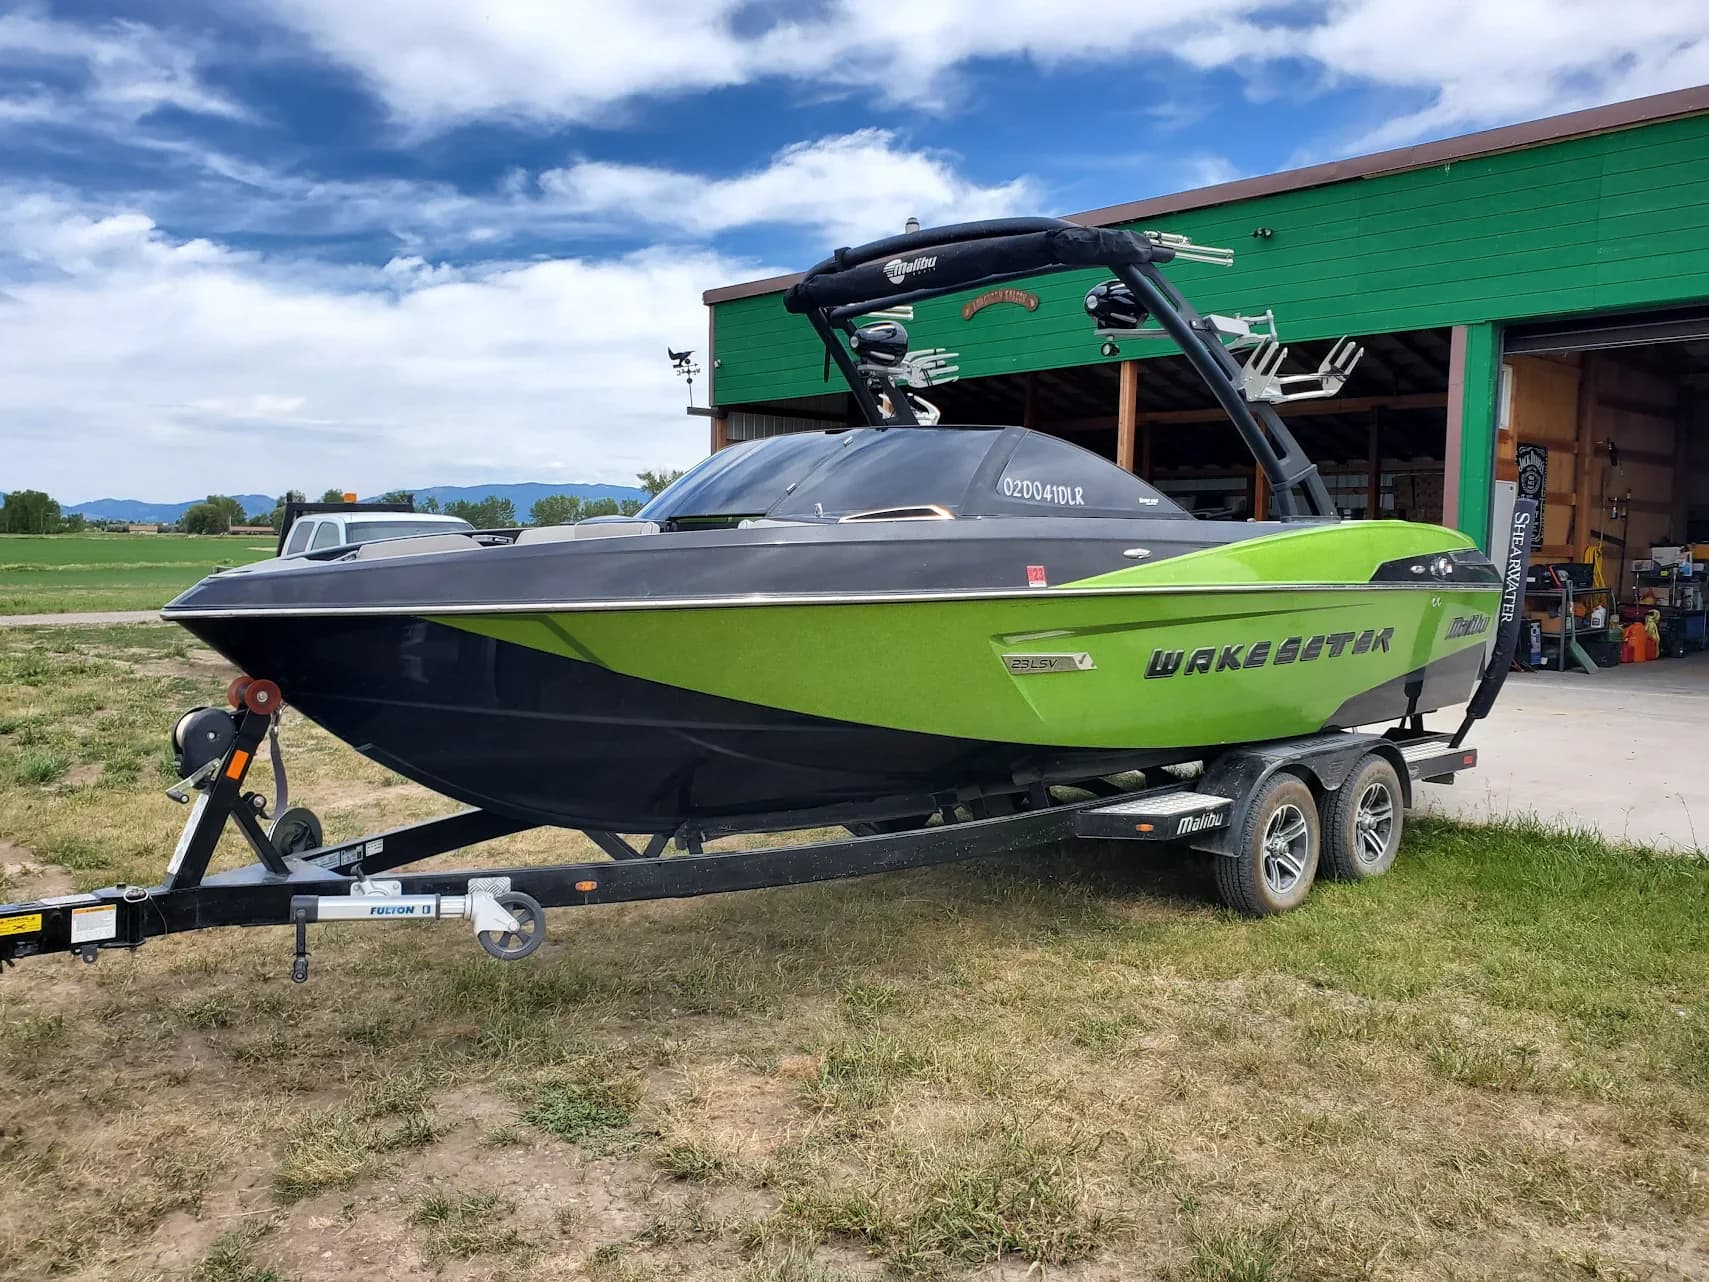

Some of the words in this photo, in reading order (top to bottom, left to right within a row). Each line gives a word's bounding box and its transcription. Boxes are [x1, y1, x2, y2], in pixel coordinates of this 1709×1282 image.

[893, 256, 937, 276] Malibu
[1501, 512, 1530, 623] SHEARWATER
[1011, 659, 1058, 669] 23LSV
[1176, 811, 1224, 835] Malibu
[370, 905, 415, 915] FULTON
